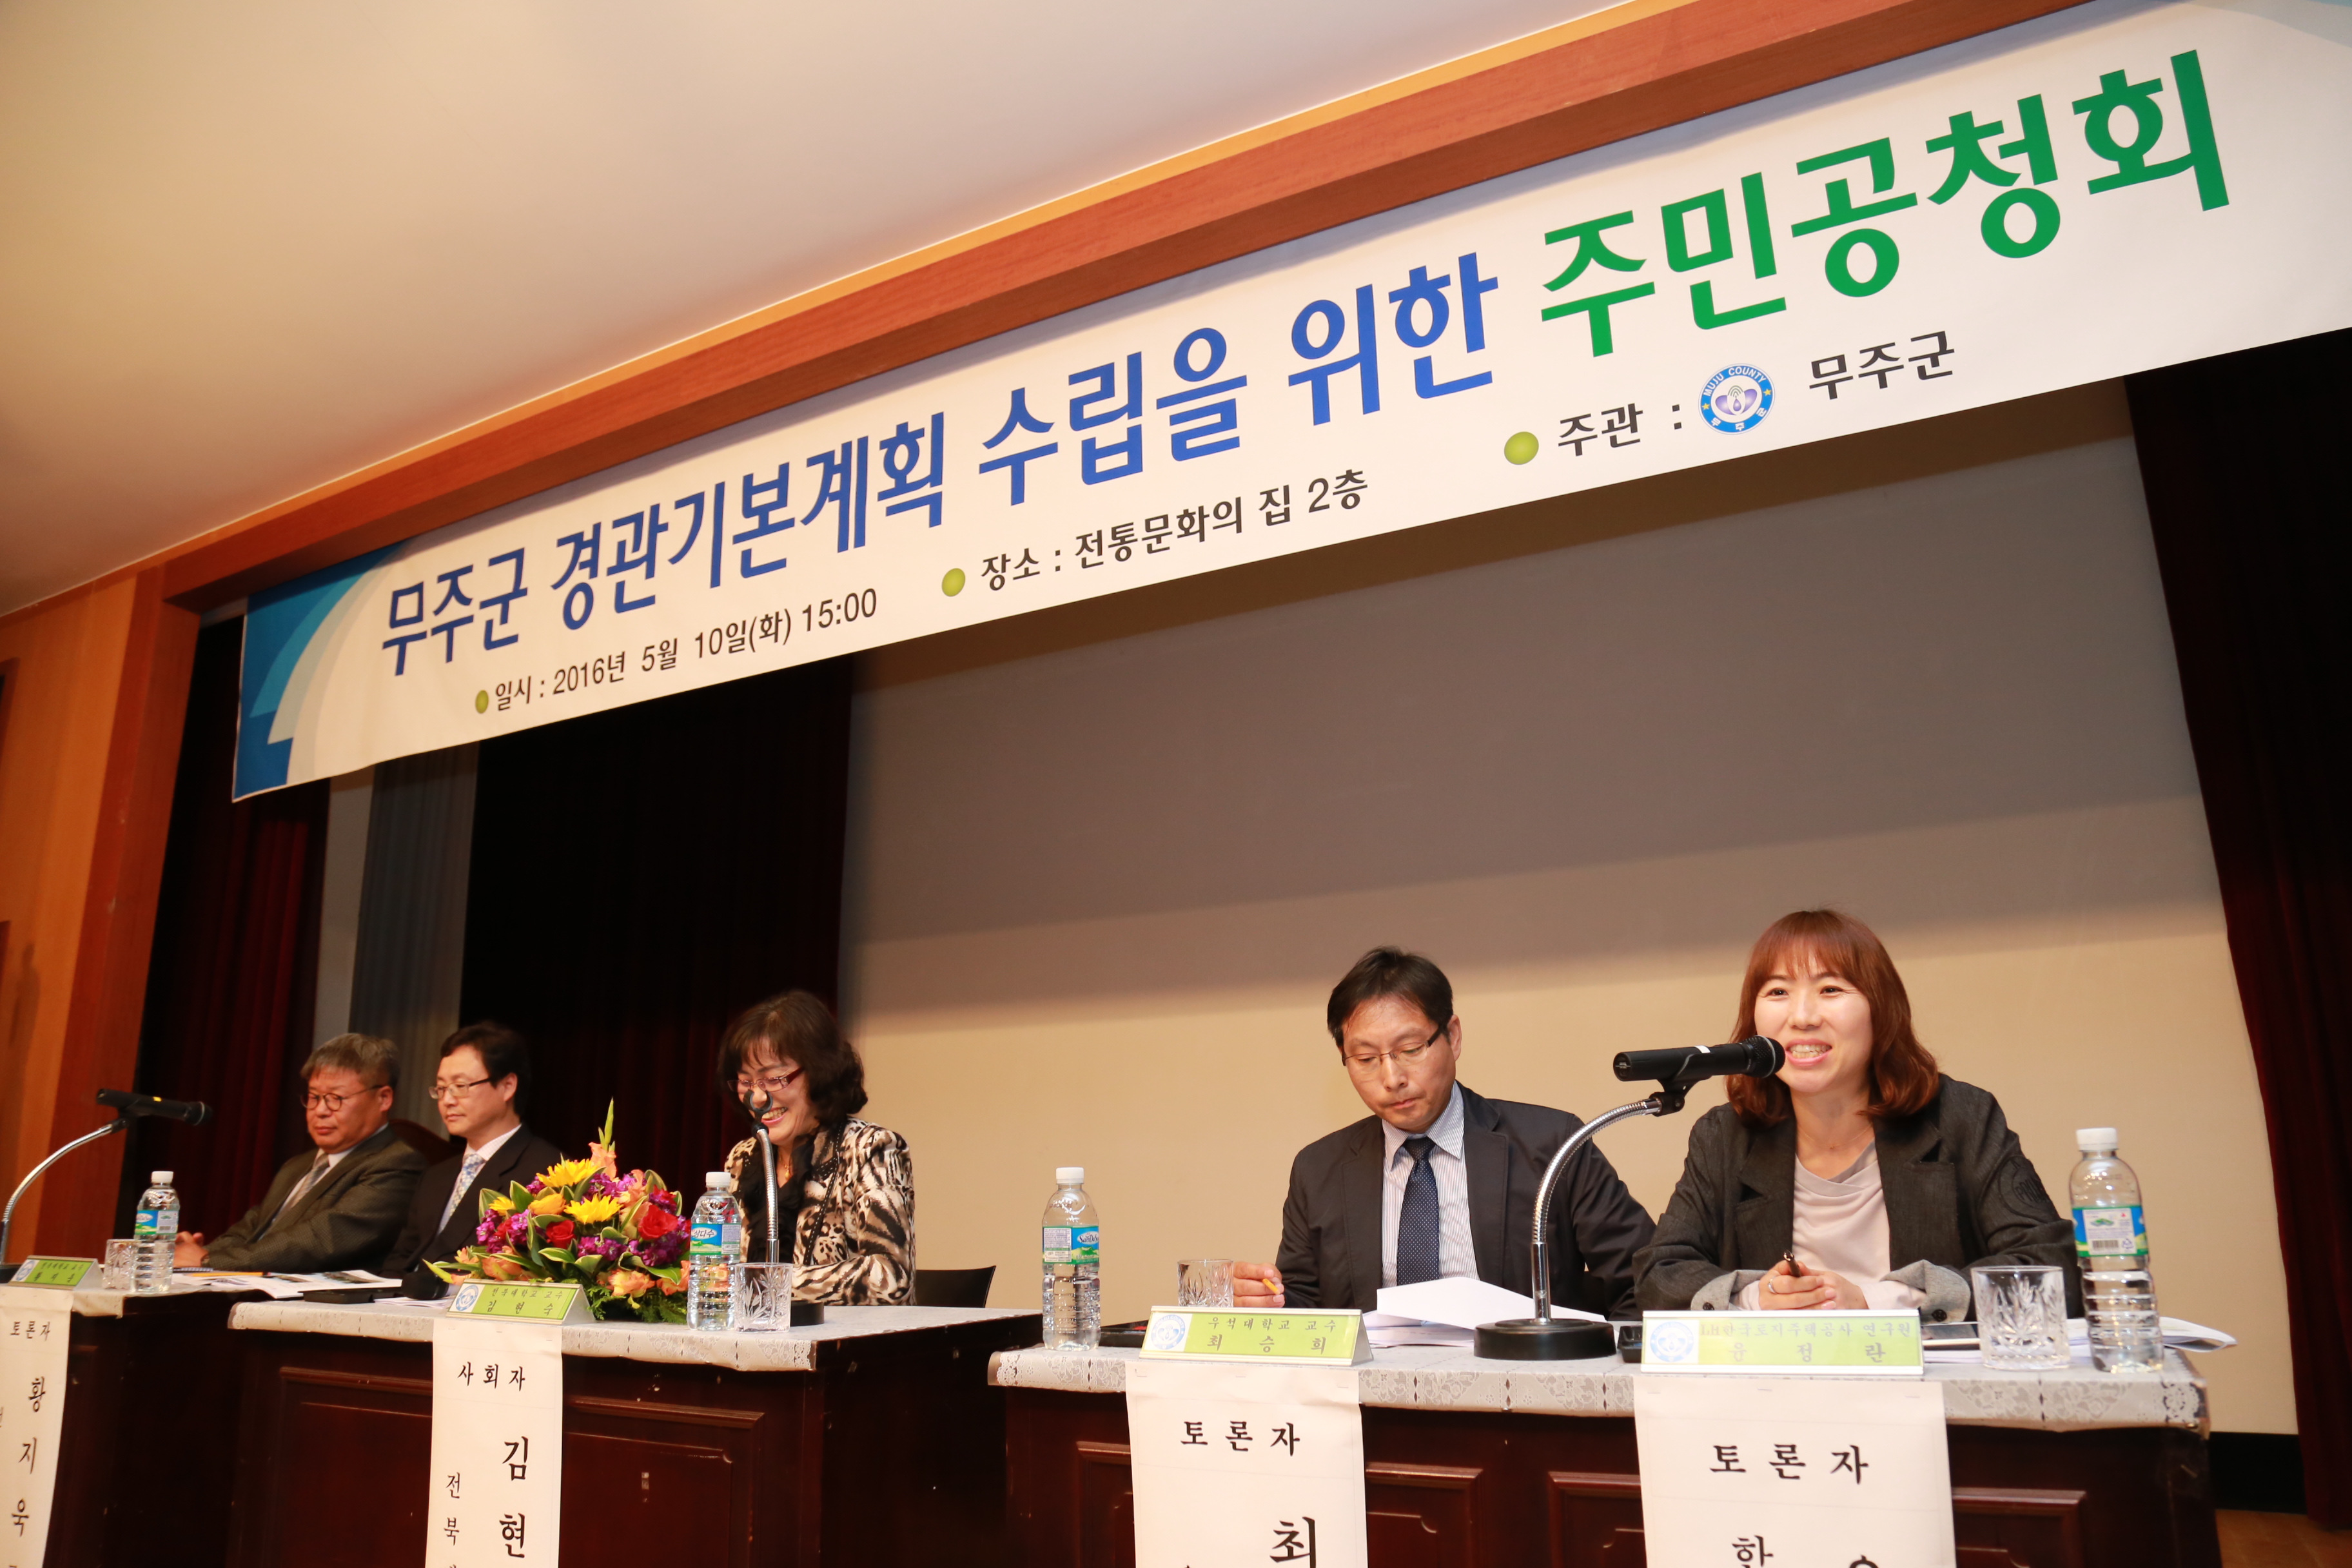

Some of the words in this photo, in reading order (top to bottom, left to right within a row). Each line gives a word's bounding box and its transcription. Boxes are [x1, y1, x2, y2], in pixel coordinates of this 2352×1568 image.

[382, 548, 527, 676] 무주군
[551, 411, 945, 630] 경관기본계획
[979, 327, 1248, 506] 수립을
[1288, 252, 1499, 426] 위한
[1540, 49, 2230, 358] 주민공청회
[1703, 373, 1724, 397] MUJU
[1728, 366, 1767, 383] COUNTY
[1808, 330, 1955, 400] 무주군
[1557, 402, 1643, 457] 주관
[981, 547, 1041, 592] 장소
[1075, 496, 1243, 571] 전통문화의
[1259, 485, 1291, 526] 집
[1308, 469, 1368, 513] 2층
[495, 675, 533, 712] 일시
[553, 651, 625, 696] 2016년
[642, 638, 678, 672] 5월
[694, 609, 792, 660] 10일(화)
[801, 587, 877, 634] 15:00
[492, 1287, 538, 1298] 전북대학교
[544, 1290, 564, 1300] 교수
[1208, 1317, 1289, 1331] 우석대학교
[1305, 1318, 1337, 1333] 교수
[1700, 1322, 1853, 1338] LH한국토지주택공사
[1863, 1322, 1910, 1338] 연구원
